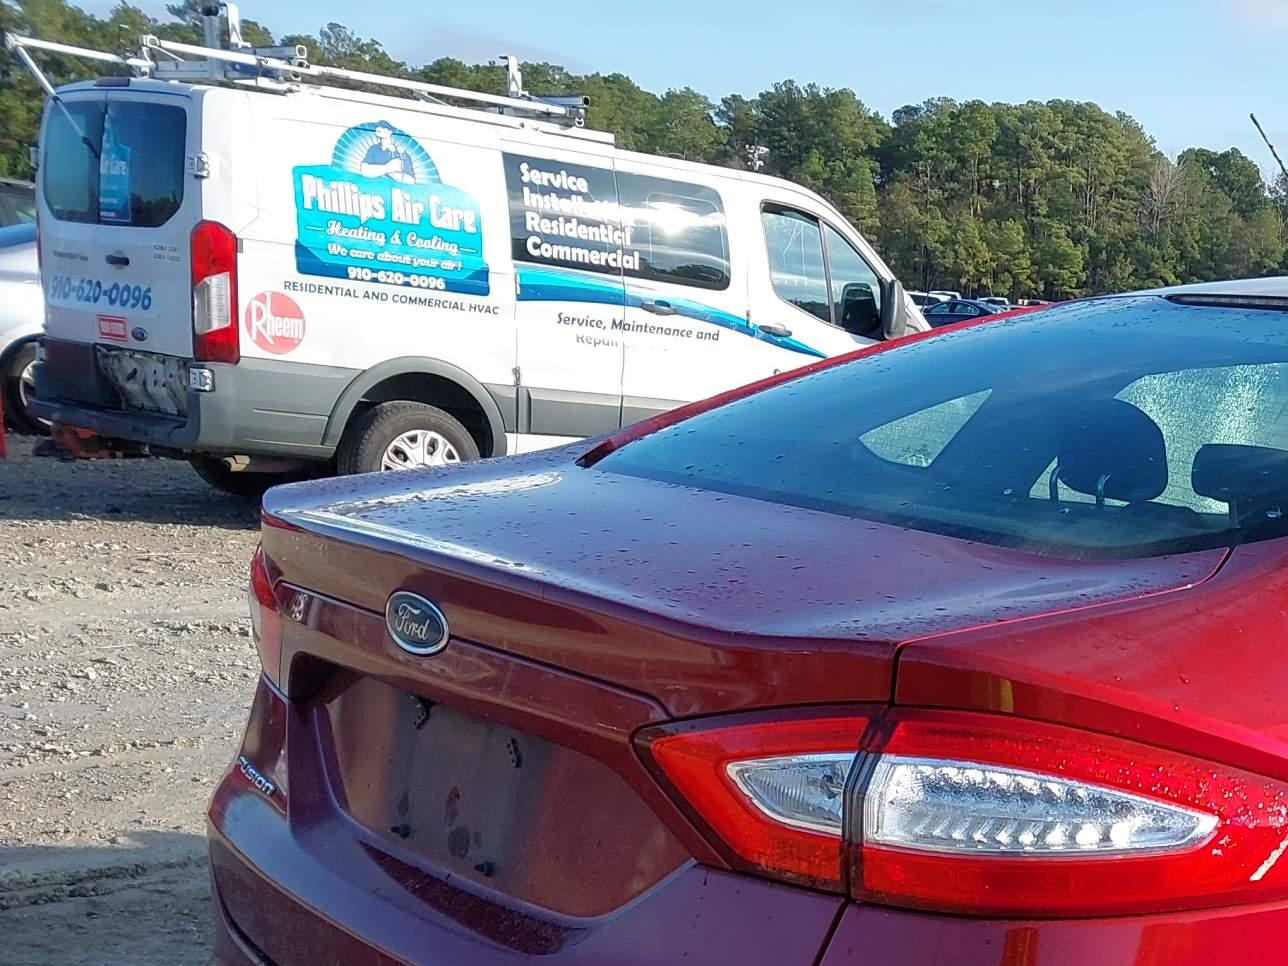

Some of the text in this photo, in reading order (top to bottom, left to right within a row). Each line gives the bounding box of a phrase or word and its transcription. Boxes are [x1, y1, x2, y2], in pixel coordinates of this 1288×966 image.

[519, 161, 589, 193] Service
[301, 173, 477, 234] Phillips Air Care
[326, 220, 460, 256] Heating & Cooling
[327, 243, 347, 257] We
[349, 247, 375, 260] care
[376, 250, 412, 265] about
[411, 257, 441, 268] your
[526, 234, 641, 271] Commercial
[50, 274, 152, 311] 910-620-0096
[347, 265, 446, 291] 910-620-0096
[283, 280, 500, 315] RESIDENTIAL AND COMMERCIAL HVAC
[251, 290, 302, 345] Rheem
[556, 311, 720, 341] Service, Maintenance and
[395, 603, 431, 640] Ford
